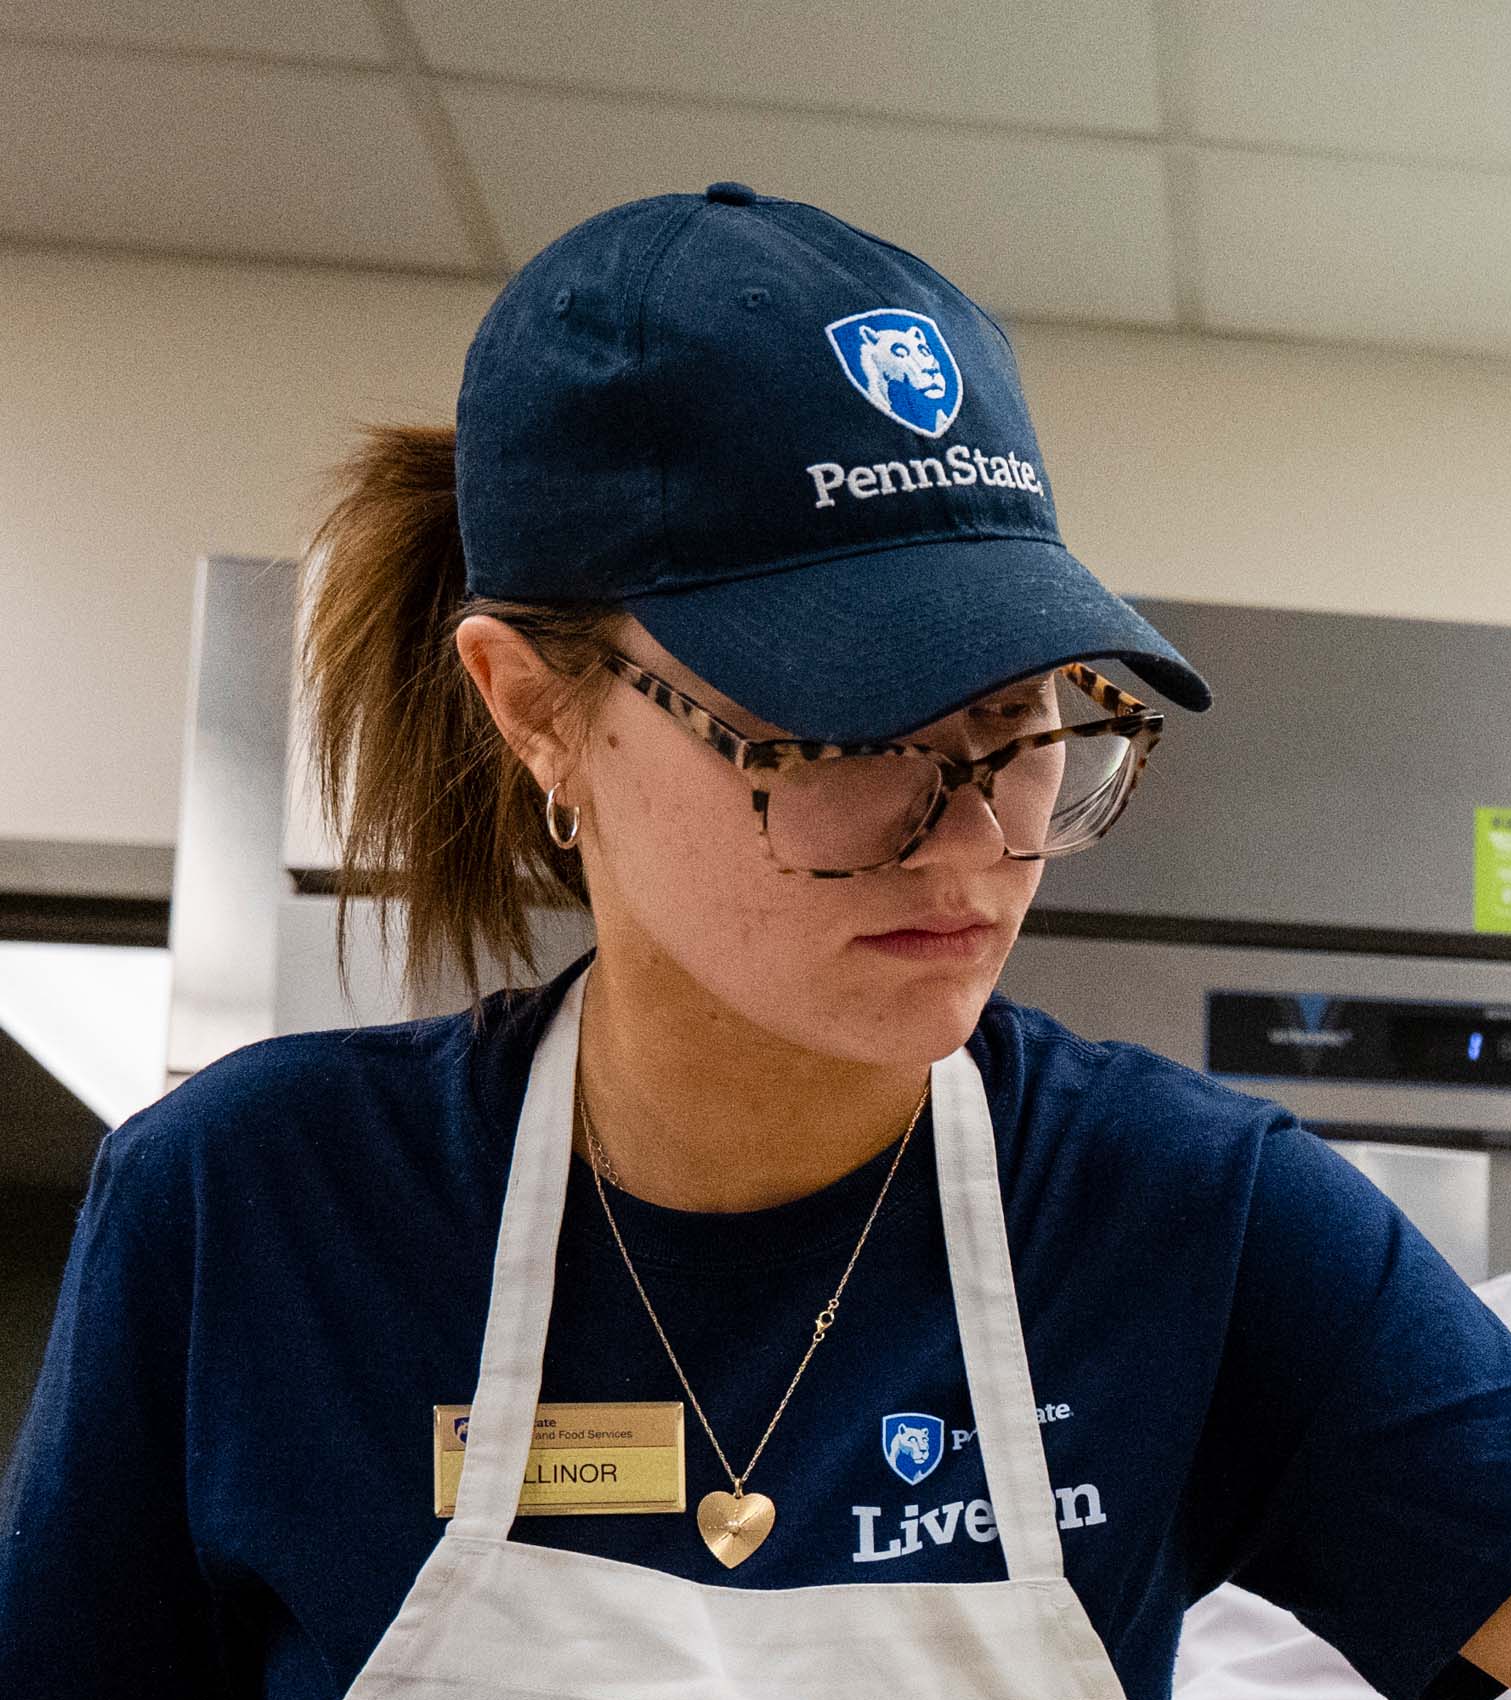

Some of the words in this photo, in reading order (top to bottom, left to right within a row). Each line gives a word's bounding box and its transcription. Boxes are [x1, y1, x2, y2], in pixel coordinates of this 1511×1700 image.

[806, 445, 1041, 509] PennState
[535, 1431, 555, 1440] and
[559, 1430, 585, 1440] Food
[588, 1429, 633, 1439] Services
[523, 1463, 618, 1484] LLINOR
[852, 1483, 1107, 1562] Liven
